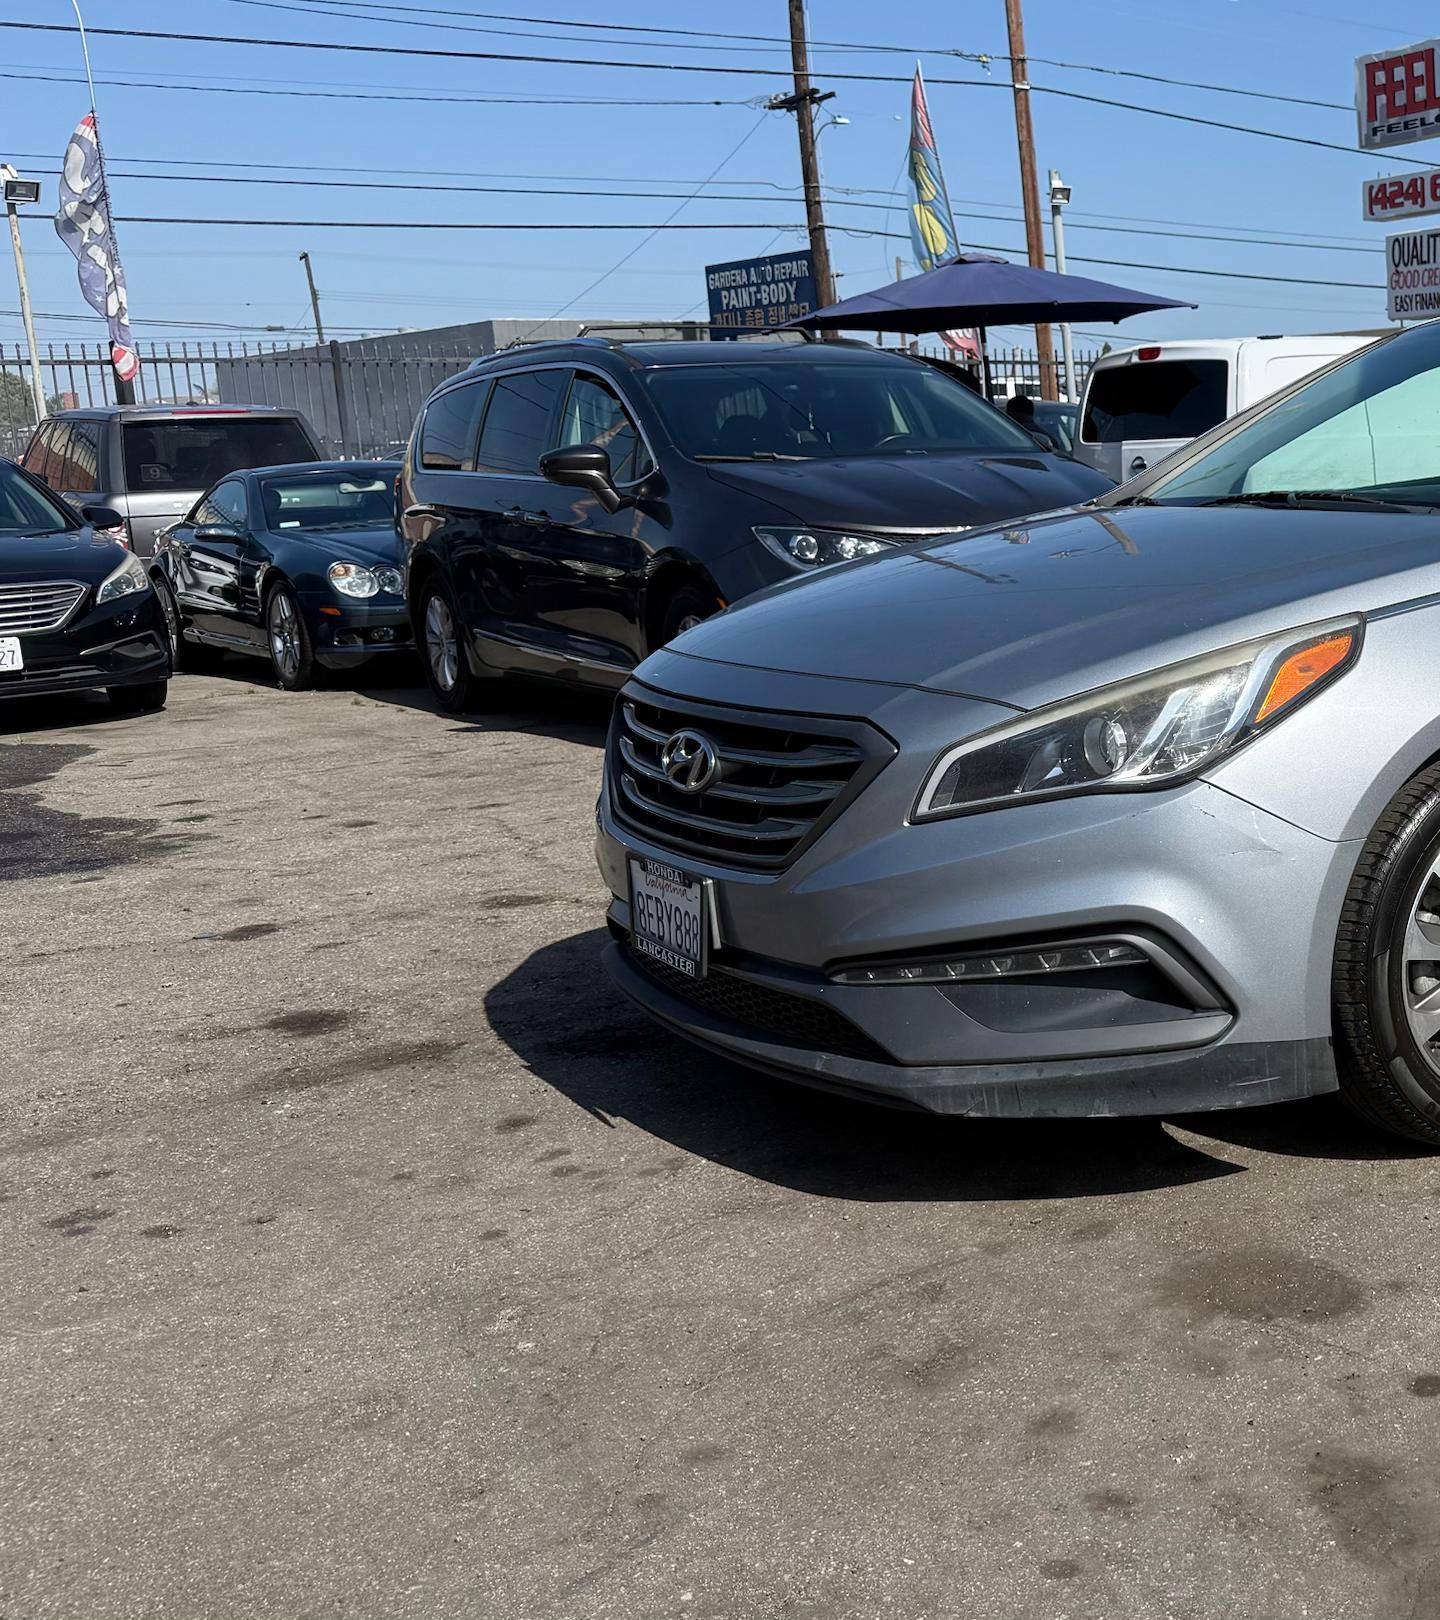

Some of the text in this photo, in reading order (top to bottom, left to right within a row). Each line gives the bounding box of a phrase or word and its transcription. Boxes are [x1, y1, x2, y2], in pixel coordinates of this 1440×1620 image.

[1368, 176, 1426, 216] (424)
[774, 260, 809, 281] REPAIR
[1391, 268, 1420, 290] GOOD
[721, 281, 797, 310] PAINT-BODY
[1394, 293, 1415, 312] EASY
[647, 861, 681, 882] HONDA
[636, 891, 700, 959] 8EBY888
[638, 938, 694, 976] LANCASTER
